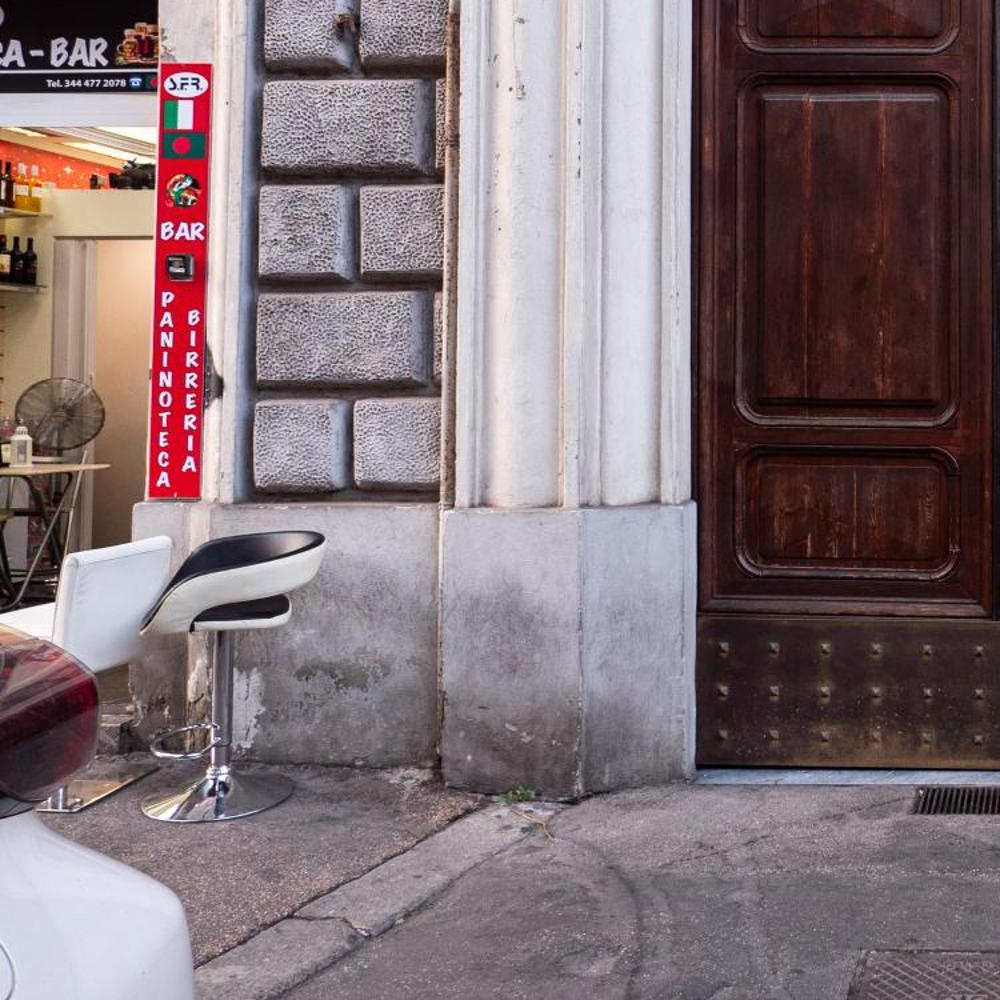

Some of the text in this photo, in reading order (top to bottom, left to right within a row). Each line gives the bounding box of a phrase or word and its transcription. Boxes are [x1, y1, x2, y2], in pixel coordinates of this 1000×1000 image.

[0, 39, 26, 67] A
[50, 37, 109, 68] BAR
[46, 79, 127, 88] Tel. 344 477 2078
[161, 221, 205, 241] BAR
[156, 291, 175, 488] PANINOTECA
[181, 309, 200, 472] BIRRERIA
